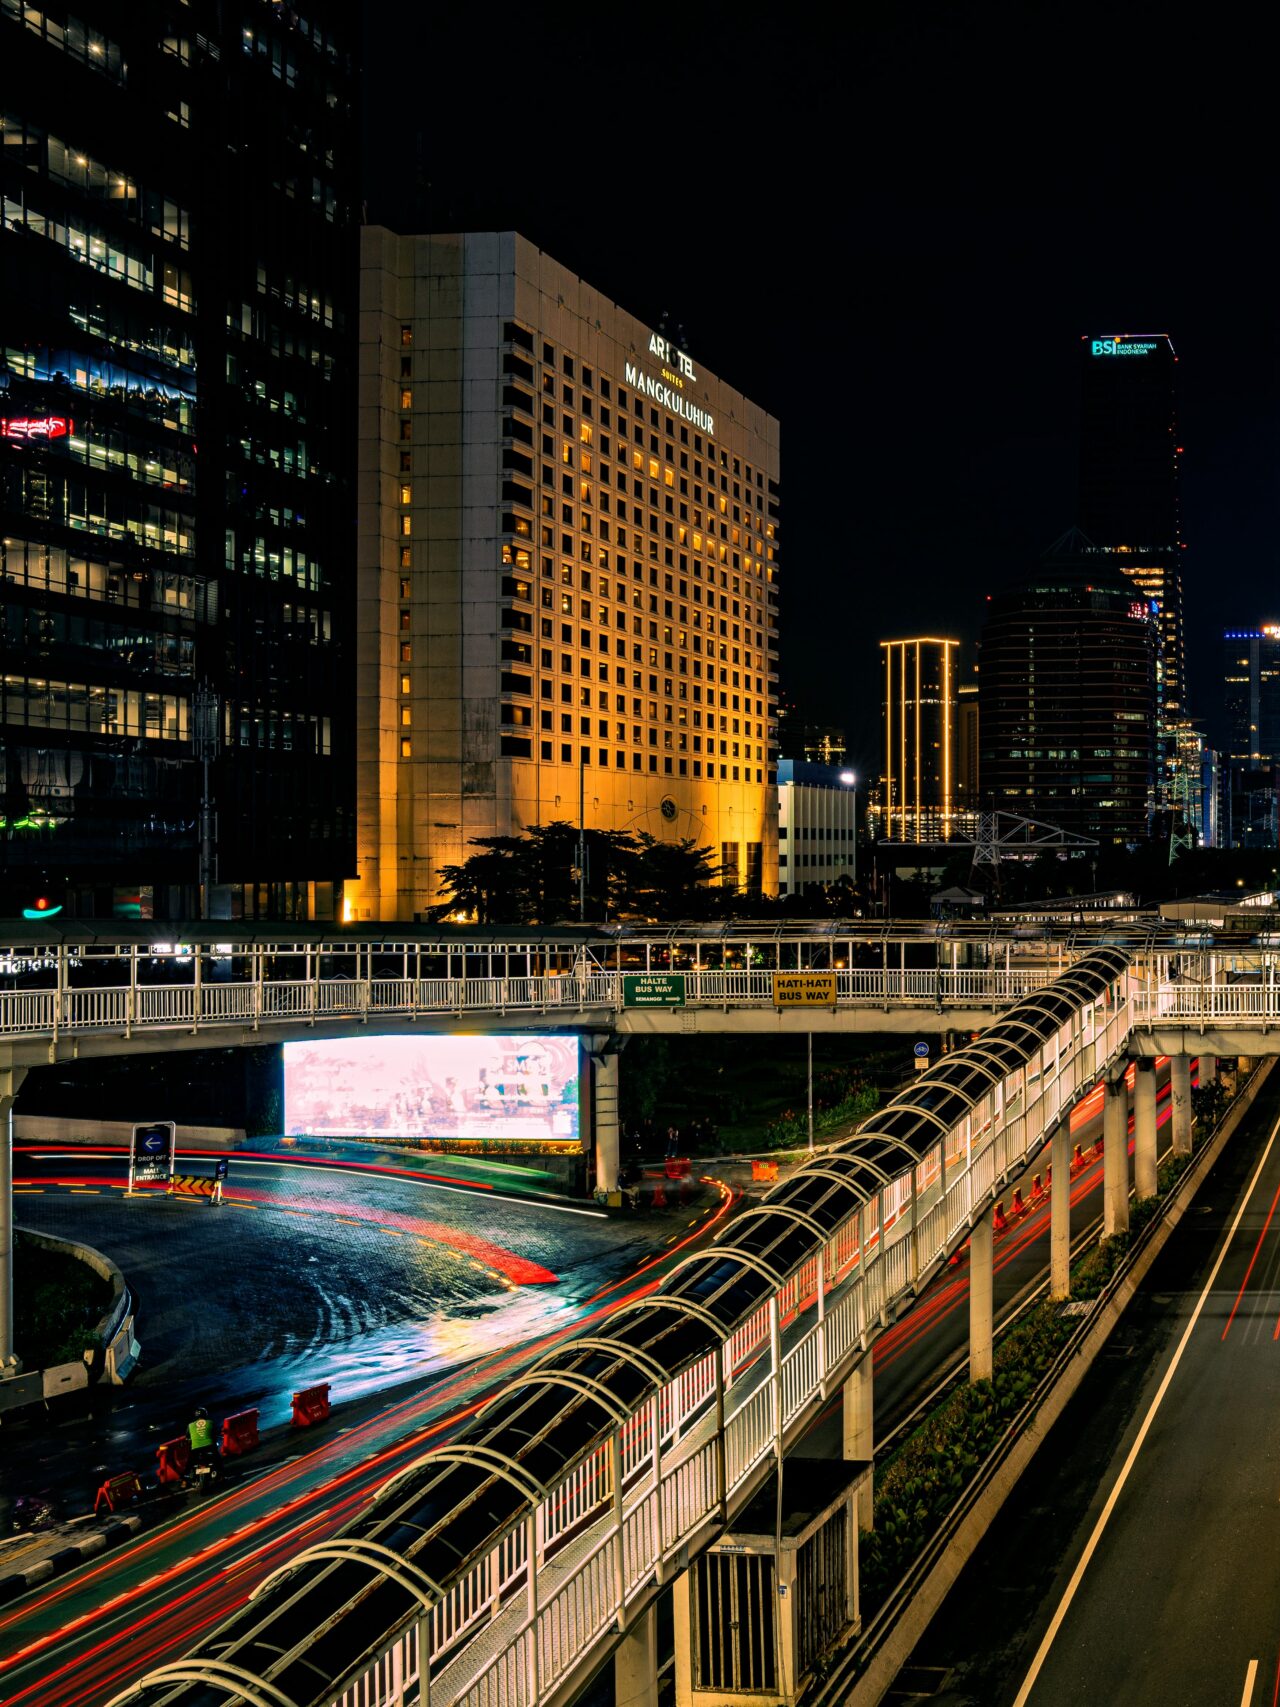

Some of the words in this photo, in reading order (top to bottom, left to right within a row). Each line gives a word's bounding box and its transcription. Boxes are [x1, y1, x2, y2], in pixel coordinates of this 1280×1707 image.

[1092, 340, 1117, 355] BSI
[661, 368, 683, 388] SUITES
[625, 362, 714, 435] MANGKULUHUR
[777, 979, 832, 988] HATI-HATI
[779, 992, 802, 1000] BUS
[806, 991, 830, 1000] WAY
[136, 1173, 168, 1181] ENTRANCE
